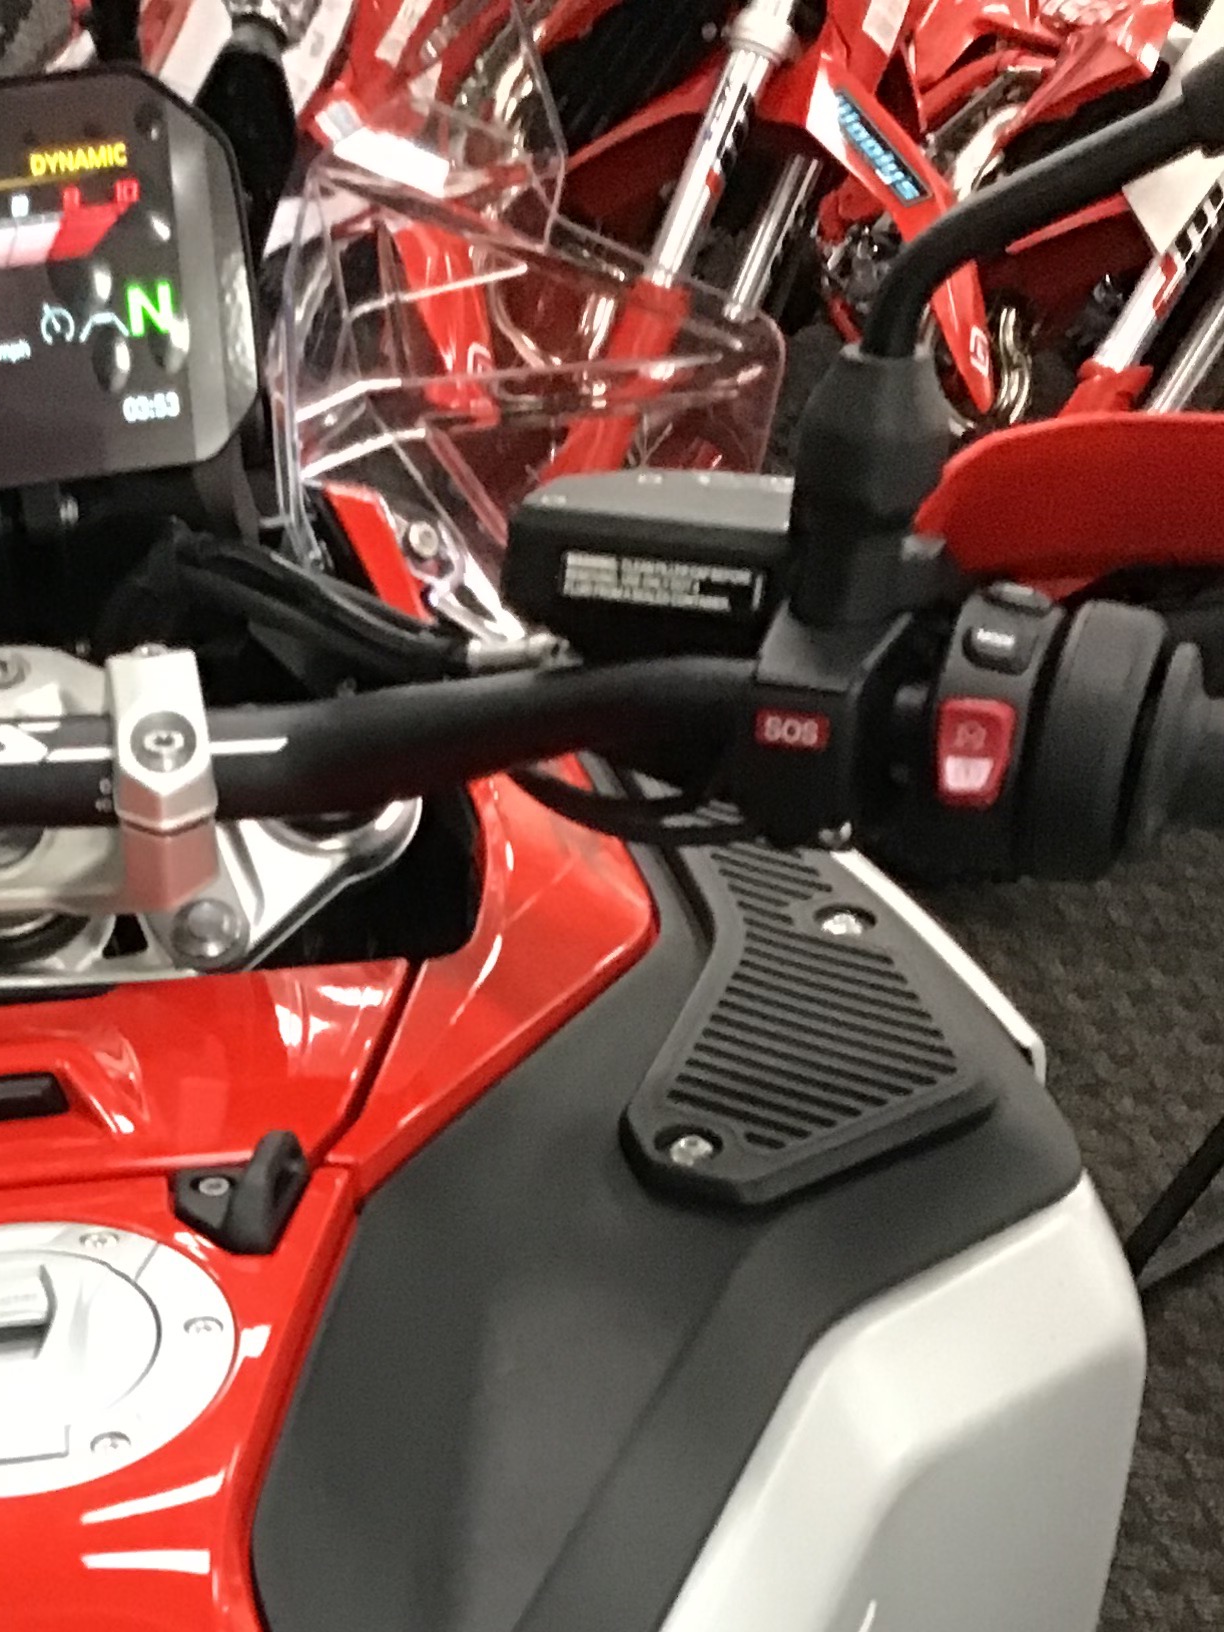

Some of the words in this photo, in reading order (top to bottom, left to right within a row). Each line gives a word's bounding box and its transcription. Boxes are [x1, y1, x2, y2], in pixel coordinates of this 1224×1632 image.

[29, 142, 128, 176] DYNAMIC
[126, 278, 174, 337] N
[764, 715, 819, 746] SOS
